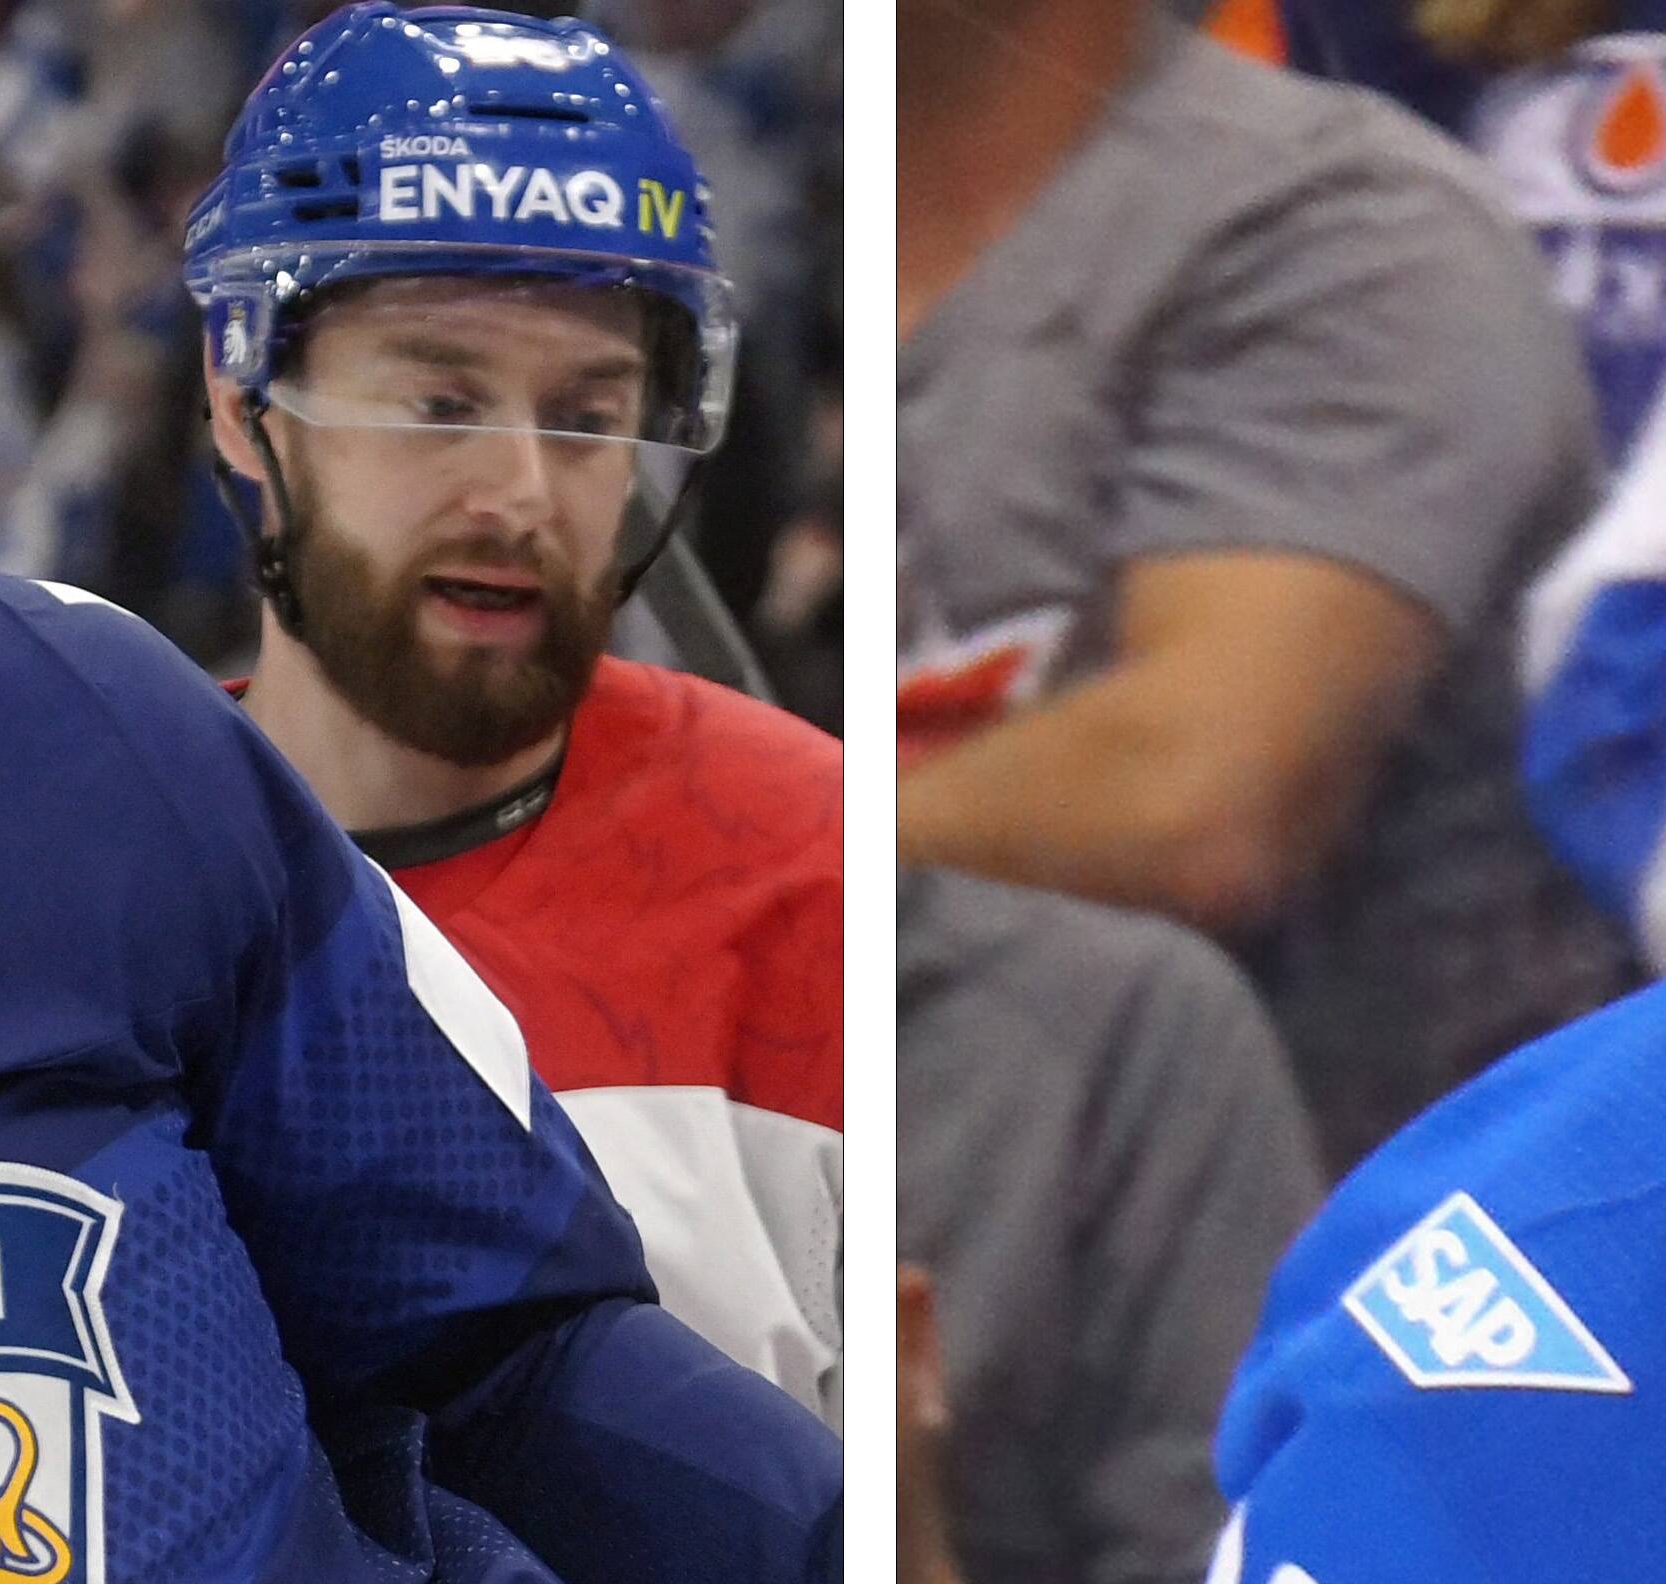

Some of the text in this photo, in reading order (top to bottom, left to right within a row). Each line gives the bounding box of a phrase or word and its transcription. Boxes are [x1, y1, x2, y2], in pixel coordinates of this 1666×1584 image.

[380, 135, 472, 158] ŠKODA
[379, 163, 623, 227] ENYAQ
[1385, 1228, 1536, 1366] SAP
